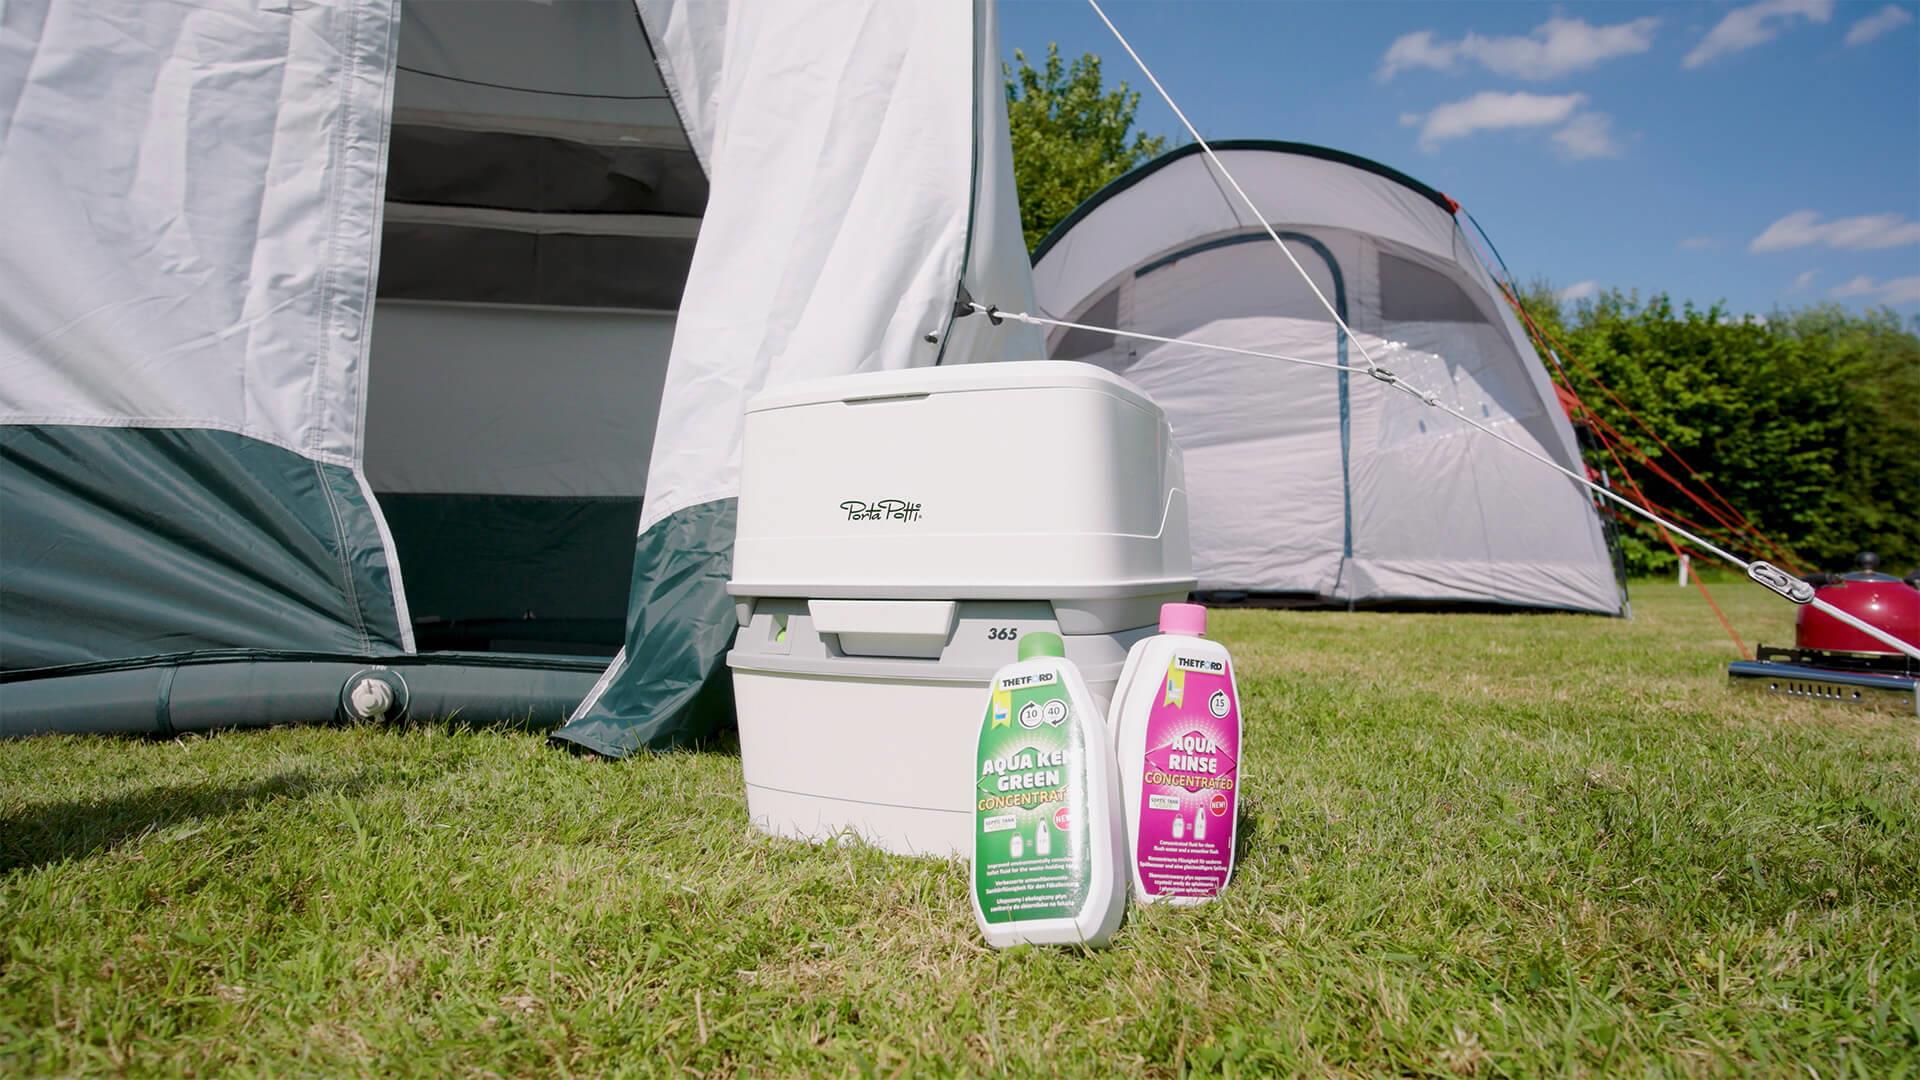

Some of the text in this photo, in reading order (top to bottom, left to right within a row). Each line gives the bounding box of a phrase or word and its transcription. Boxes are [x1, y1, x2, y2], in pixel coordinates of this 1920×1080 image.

[840, 499, 921, 523] Porta Potti
[988, 627, 1018, 640] 365
[1178, 657, 1223, 671] THETFORD
[1003, 673, 1053, 687] THETFORD
[1048, 706, 1060, 716] 40
[1215, 698, 1225, 707] 15
[1026, 709, 1038, 719] 10
[1172, 736, 1217, 755] AQUA
[983, 754, 1033, 775] AQUA
[1169, 754, 1217, 773] RINSE
[998, 770, 1059, 791] GREEN
[1145, 772, 1233, 791] CONCENTRATED
[978, 789, 1067, 811] CONCENTRAT
